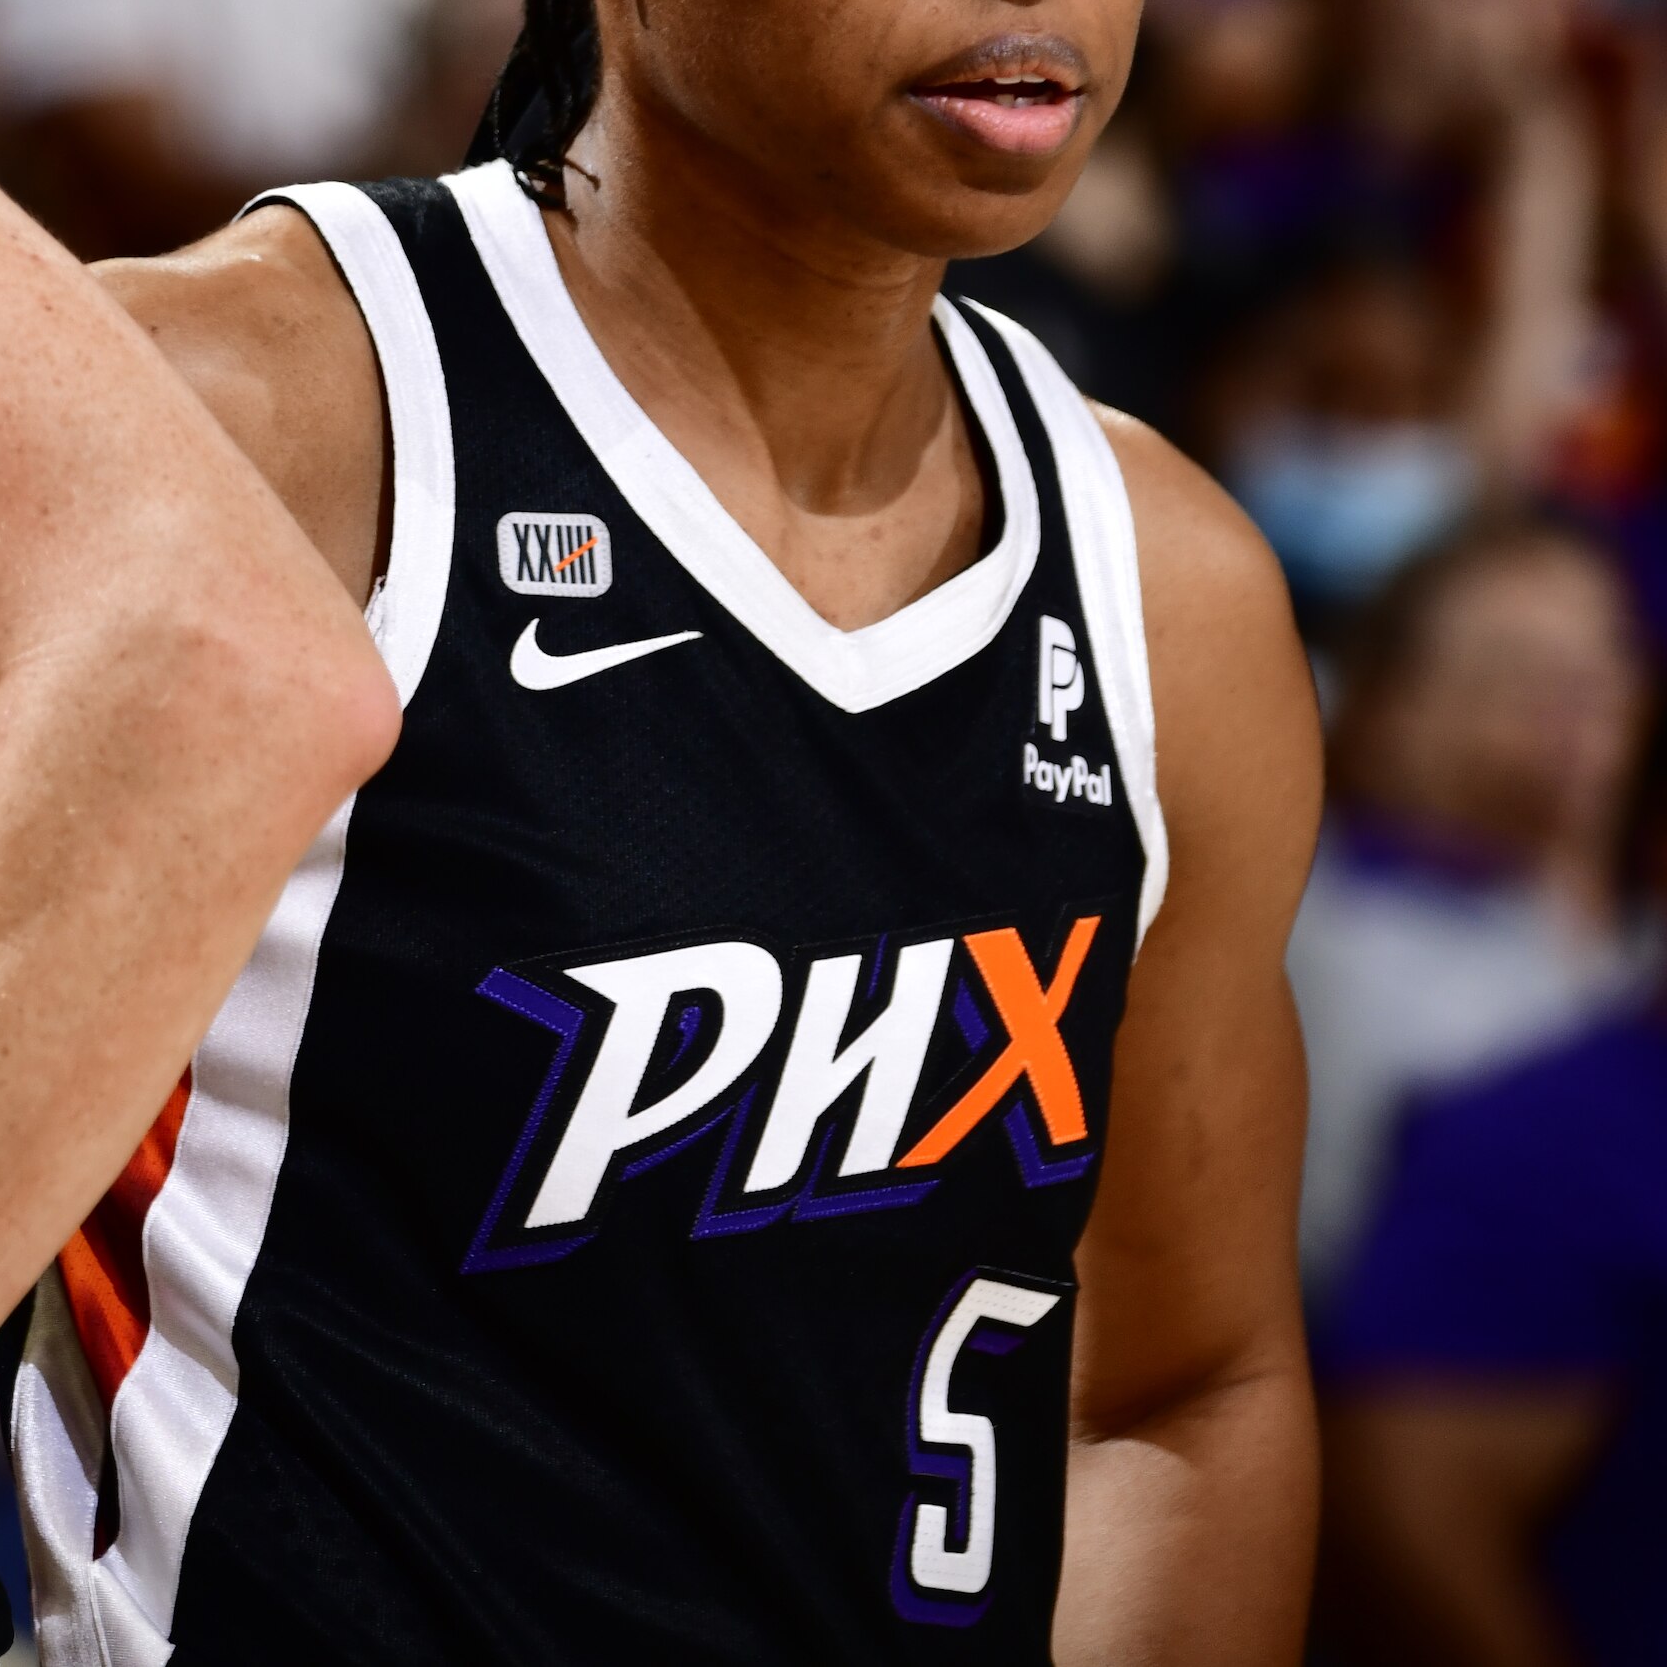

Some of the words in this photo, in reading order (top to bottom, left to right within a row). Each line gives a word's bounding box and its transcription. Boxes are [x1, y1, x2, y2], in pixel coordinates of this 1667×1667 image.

[1023, 741, 1113, 807] PayPal
[502, 916, 1103, 1246] PHX
[905, 1274, 1063, 1606] 5
